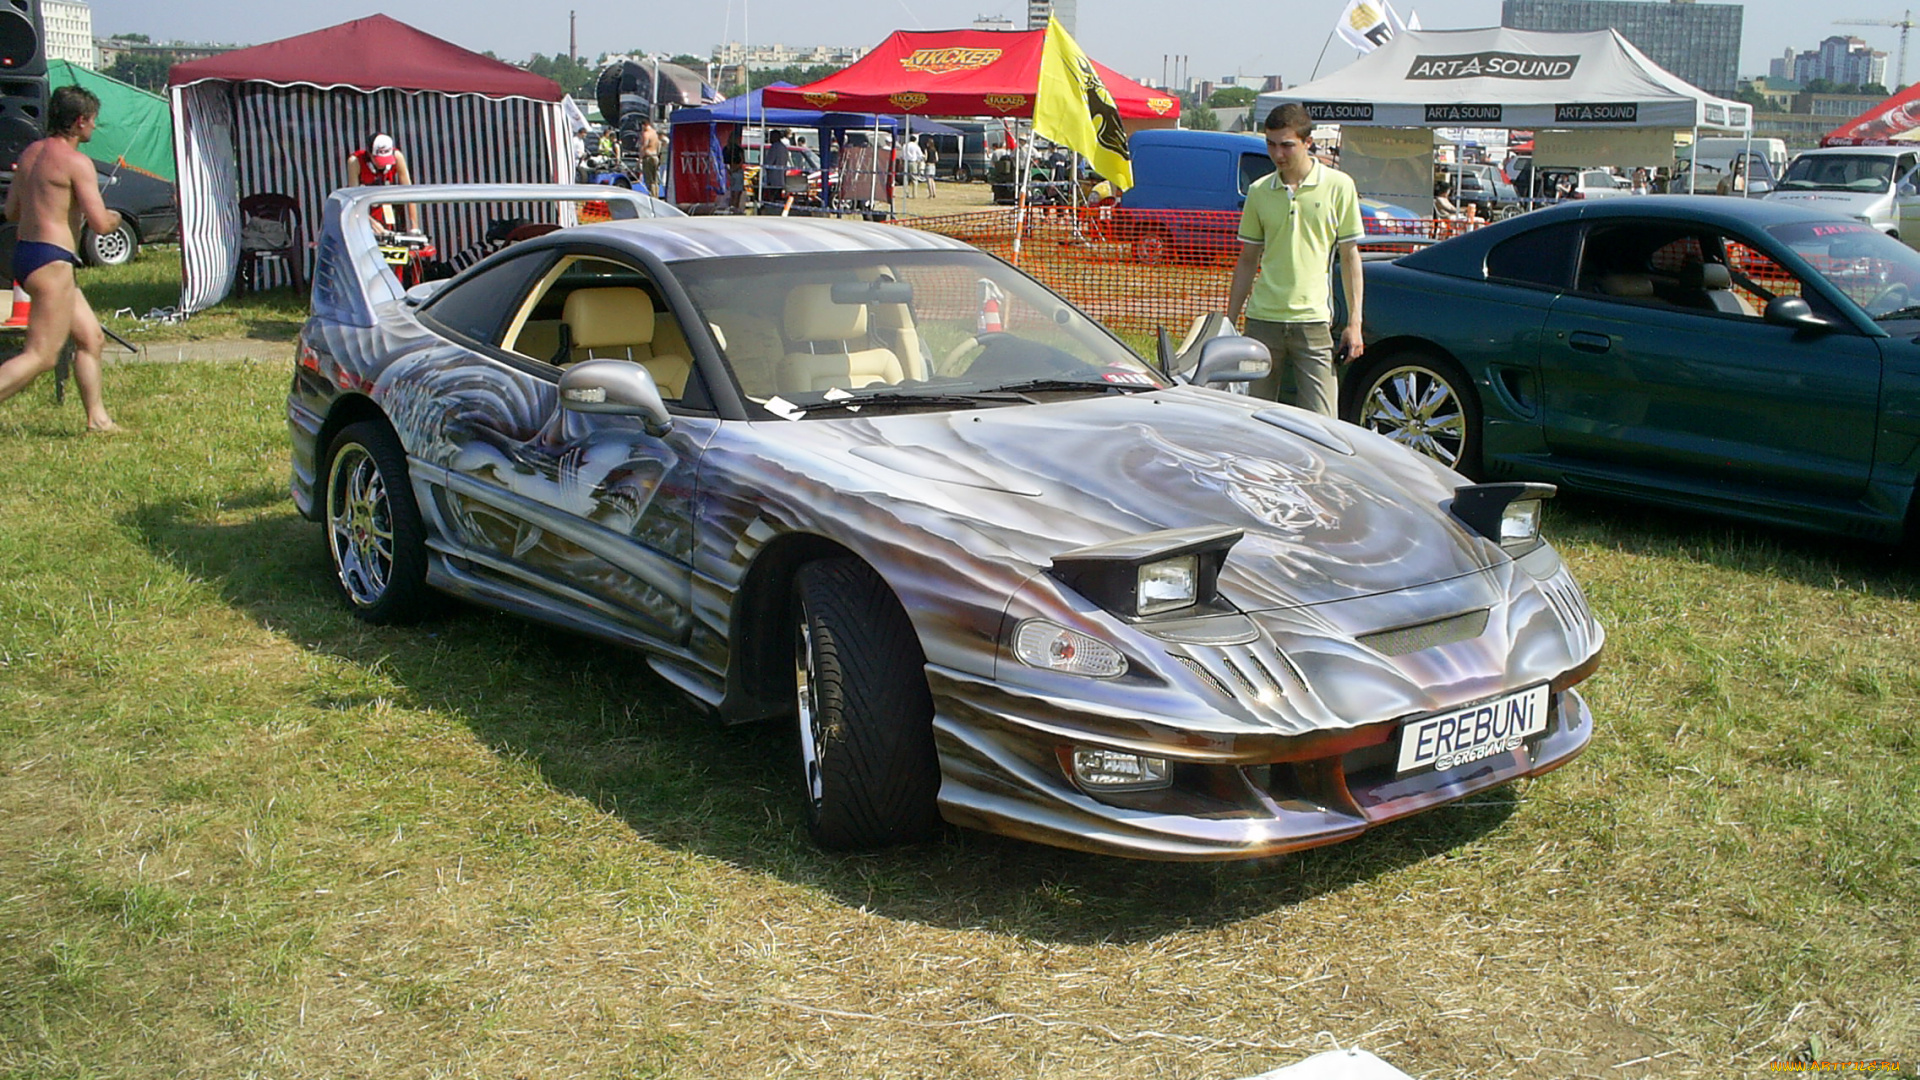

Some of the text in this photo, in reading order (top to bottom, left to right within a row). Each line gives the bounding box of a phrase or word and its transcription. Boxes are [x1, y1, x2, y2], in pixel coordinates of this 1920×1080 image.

[912, 50, 1001, 66] KICKER
[1413, 57, 1571, 76] ART SOUND
[1335, 106, 1372, 118] SOUND
[1427, 107, 1500, 119] ART SOUND
[1558, 106, 1635, 119] ART SOUND
